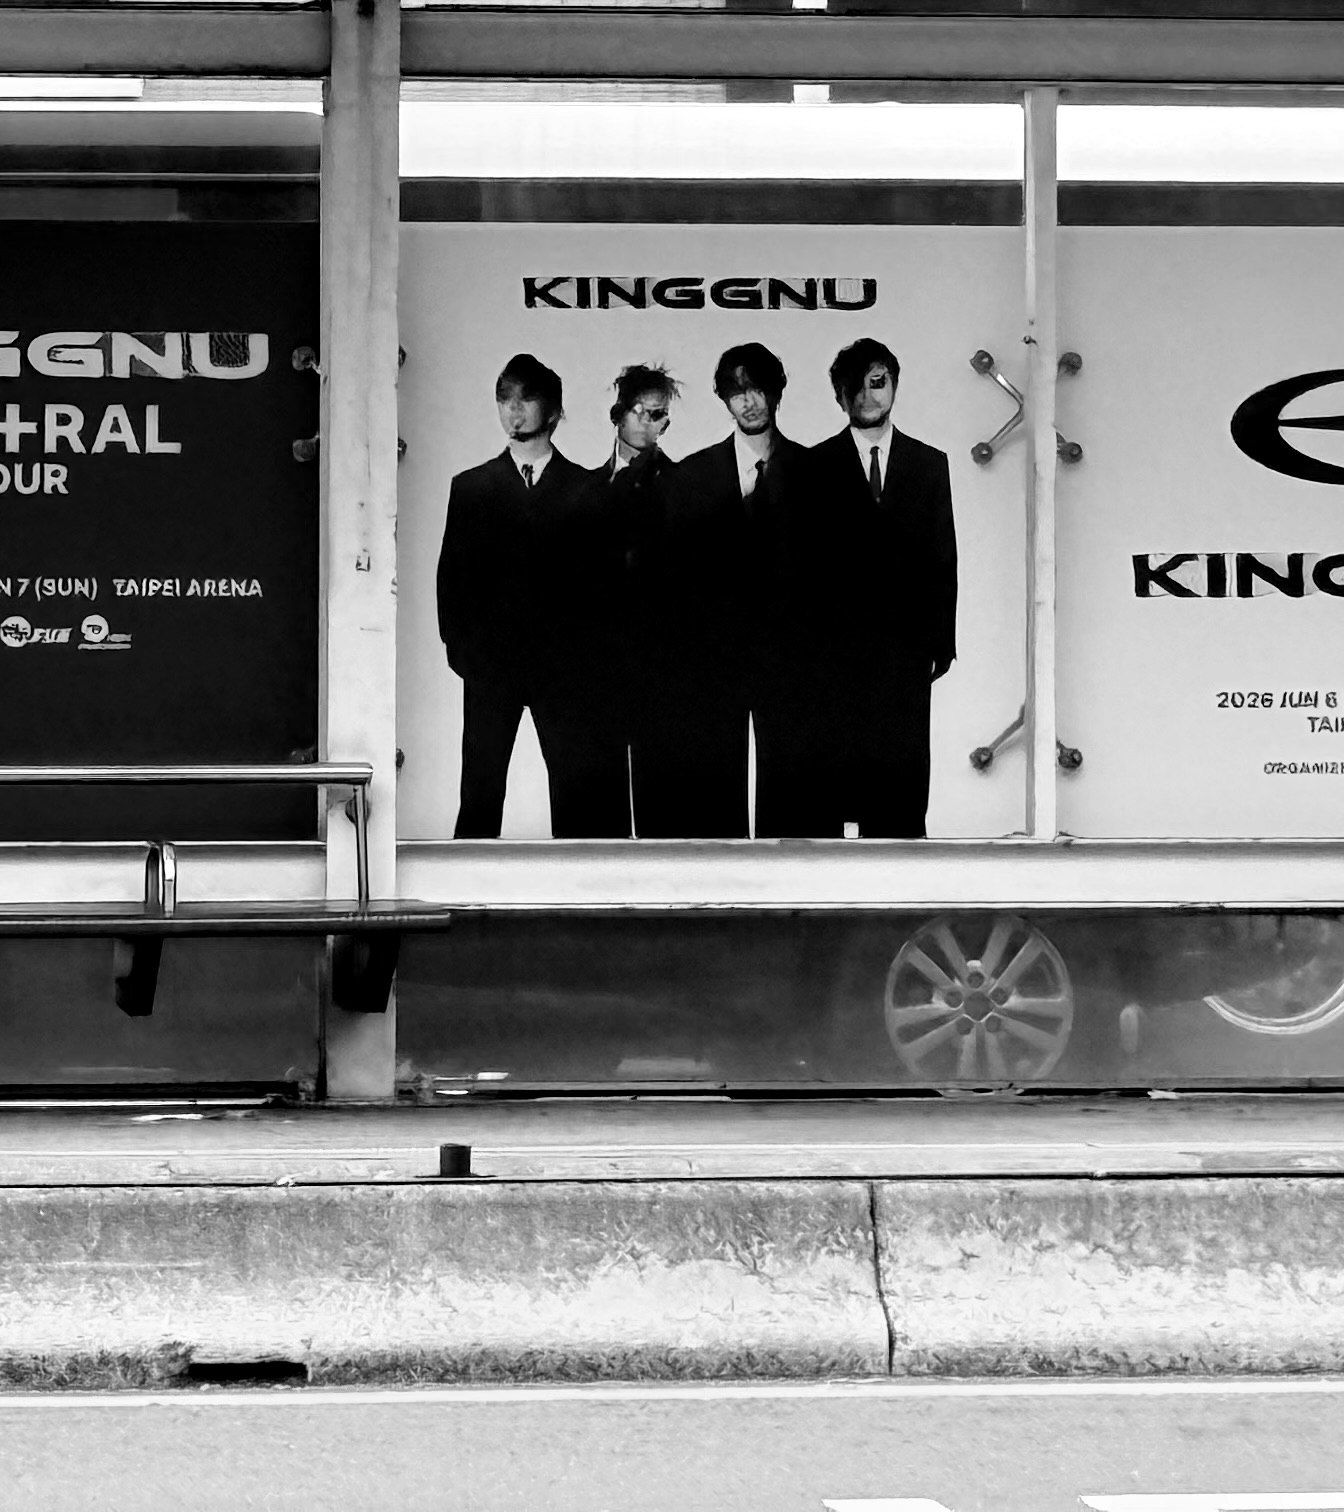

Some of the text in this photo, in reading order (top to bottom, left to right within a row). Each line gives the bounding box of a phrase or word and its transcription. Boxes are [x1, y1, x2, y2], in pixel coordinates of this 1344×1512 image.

[17, 578, 30, 597] 7
[34, 576, 98, 601] (SUN)
[112, 578, 181, 597] TAIPEI
[186, 578, 264, 597] ARENA
[1216, 691, 1274, 708] 2026
[1279, 690, 1319, 708] JUN
